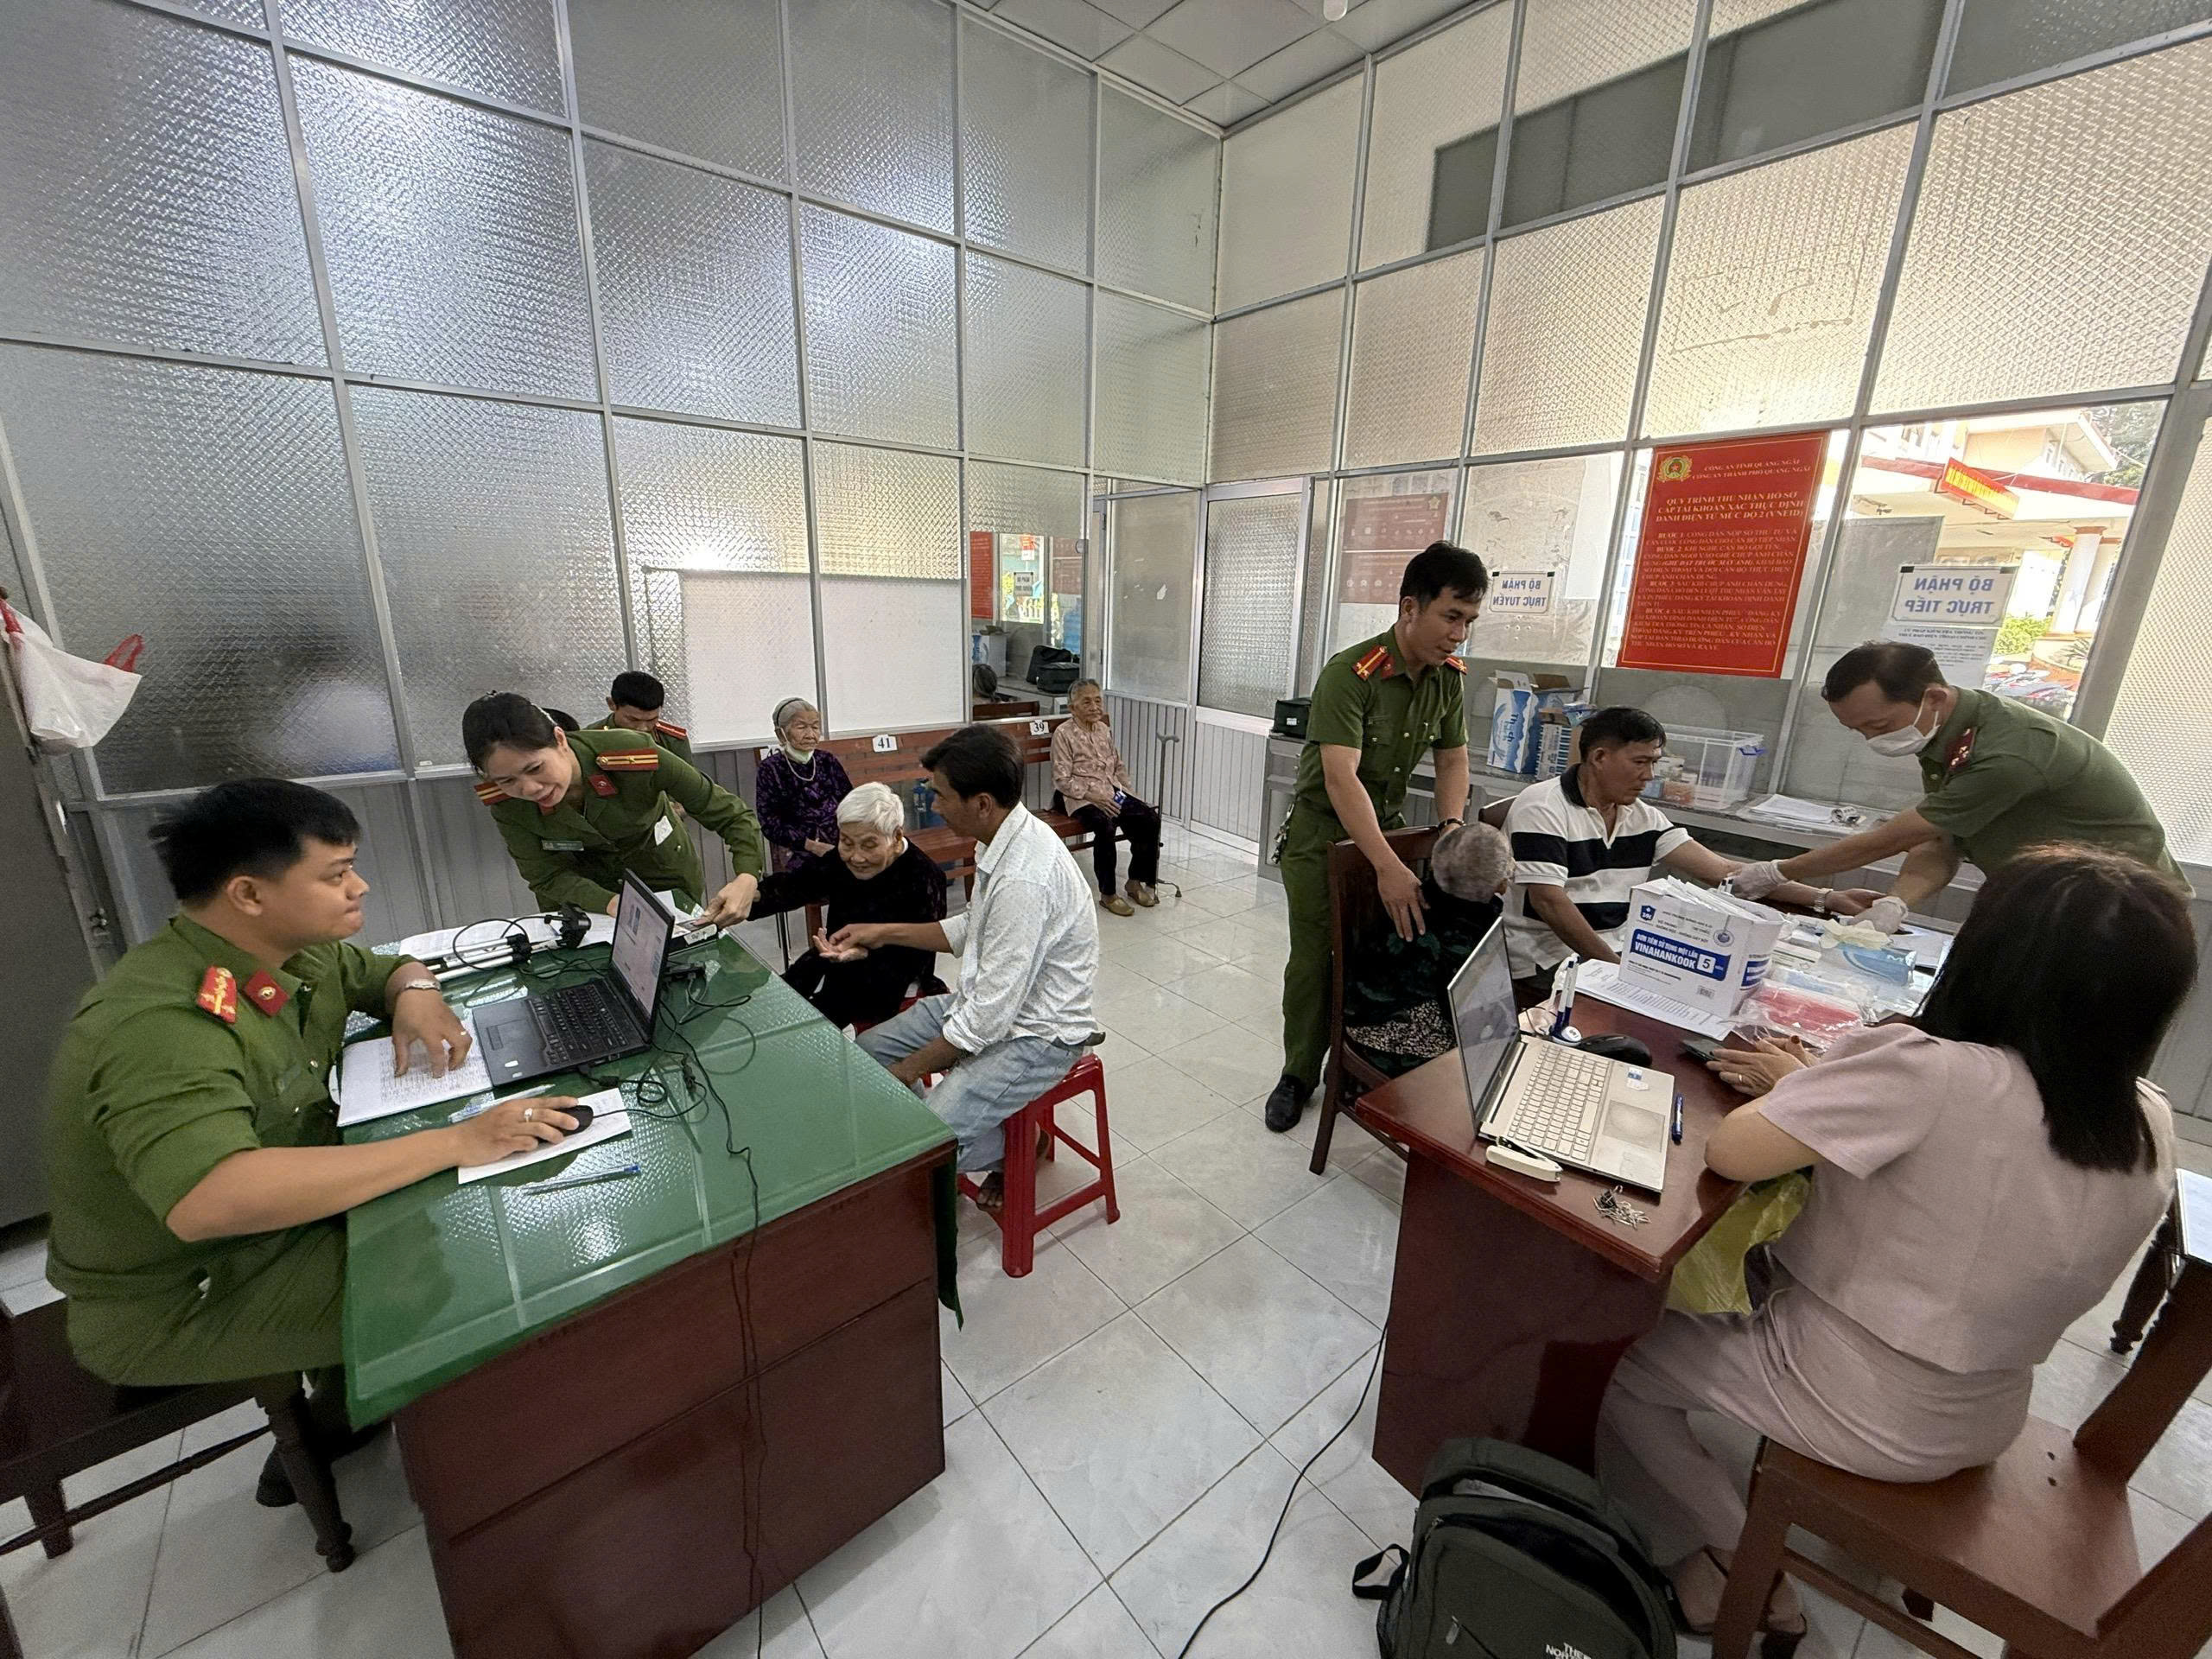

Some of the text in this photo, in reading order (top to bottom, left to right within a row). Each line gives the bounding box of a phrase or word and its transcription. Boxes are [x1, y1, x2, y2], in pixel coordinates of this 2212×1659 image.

[1033, 721, 1045, 733] 39
[877, 737, 891, 749] 41
[1635, 942, 1712, 969] VINAHANKOOK 5
